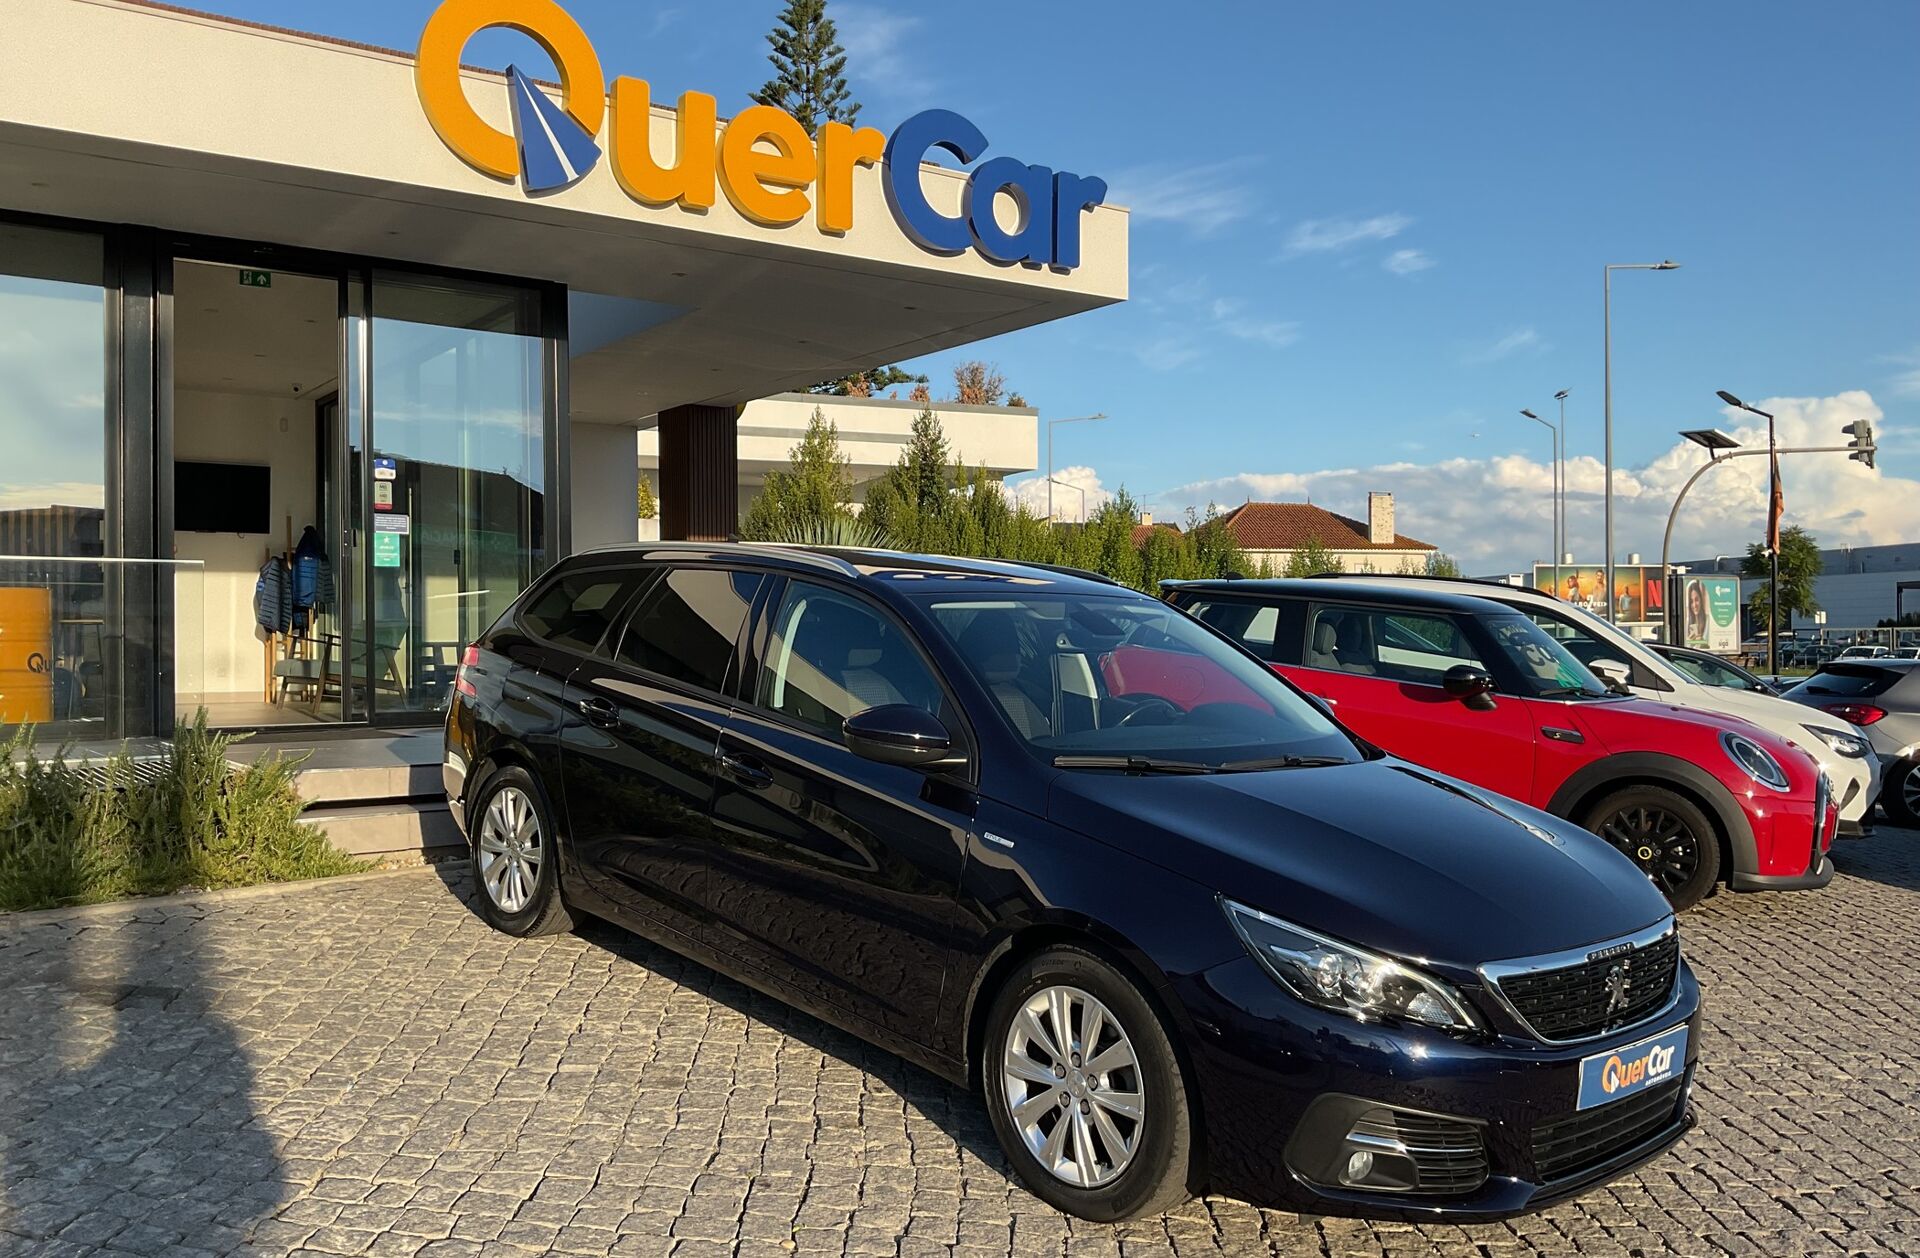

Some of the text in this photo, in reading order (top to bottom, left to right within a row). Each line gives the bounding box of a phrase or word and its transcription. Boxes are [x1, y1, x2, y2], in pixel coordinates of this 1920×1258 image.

[415, 0, 1108, 274] QuerCar
[1590, 942, 1631, 960] PEUGEOT
[1602, 1045, 1675, 1094] QuerCar
